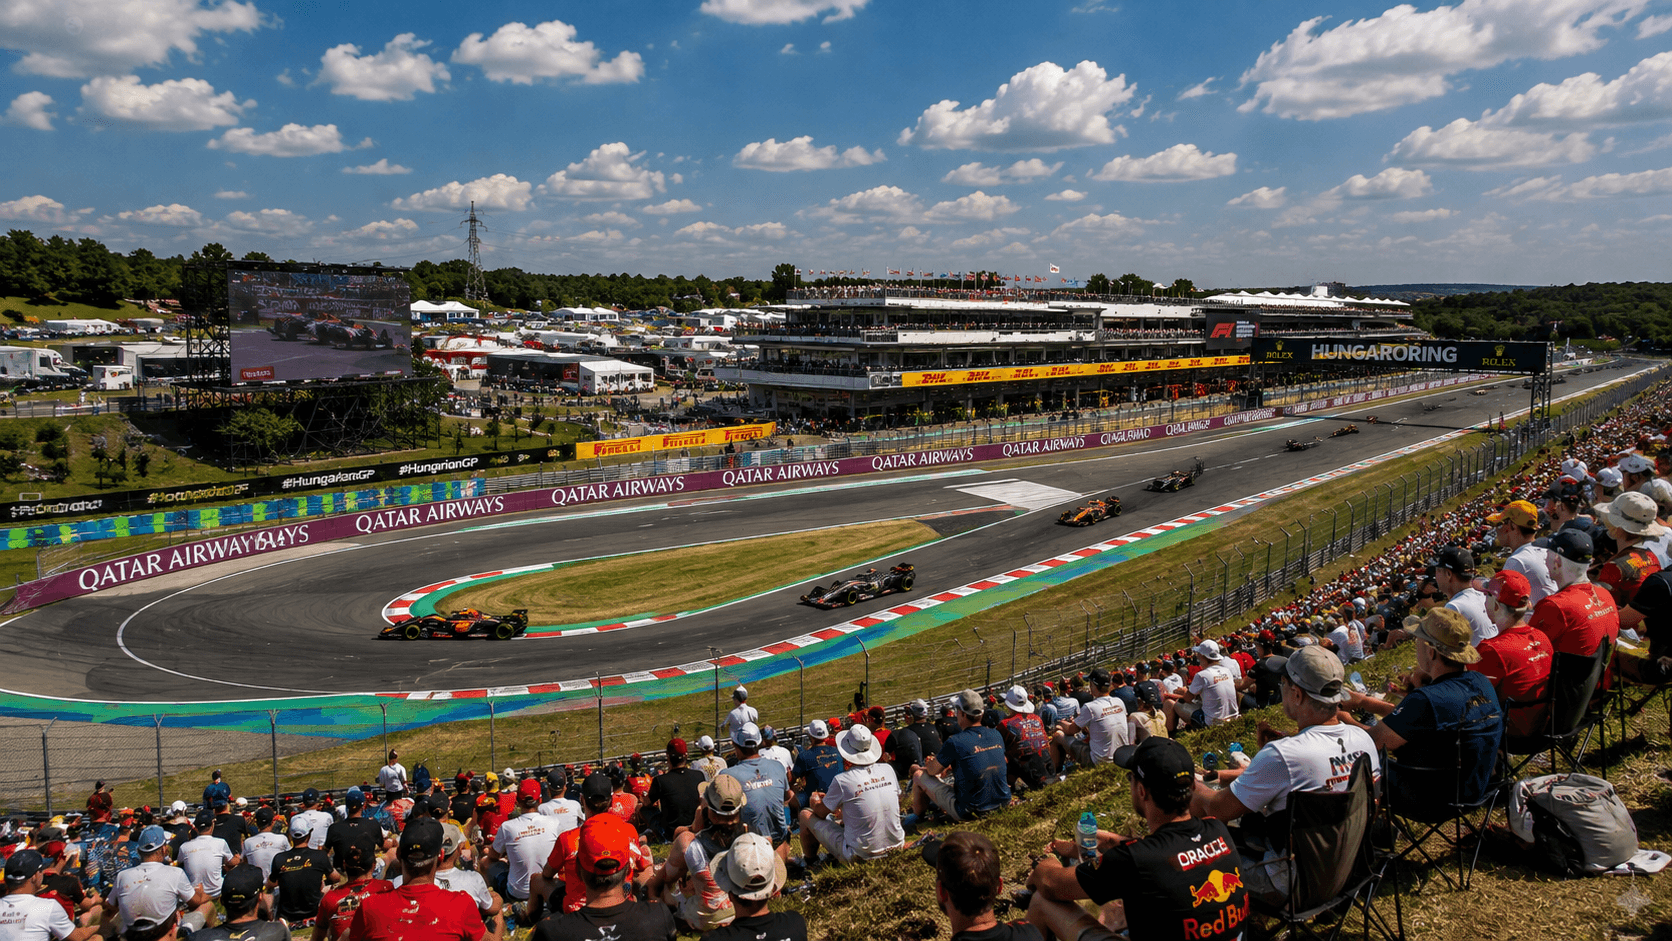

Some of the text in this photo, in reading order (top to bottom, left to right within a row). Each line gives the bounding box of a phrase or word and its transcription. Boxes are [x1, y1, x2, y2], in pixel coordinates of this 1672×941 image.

[1311, 343, 1458, 363] HUNGARORING
[871, 448, 974, 471] QATAR AIRWAYS
[1002, 441, 1041, 458] QATAR
[1042, 435, 1085, 453] AIRWAYS
[722, 461, 840, 487] QATAR AIRWAYS
[551, 476, 684, 506] QATAR AIRWAYS
[356, 496, 504, 534] QATAR AIRWAYS
[78, 553, 163, 592] QATAR
[1183, 909, 1225, 940] Red
